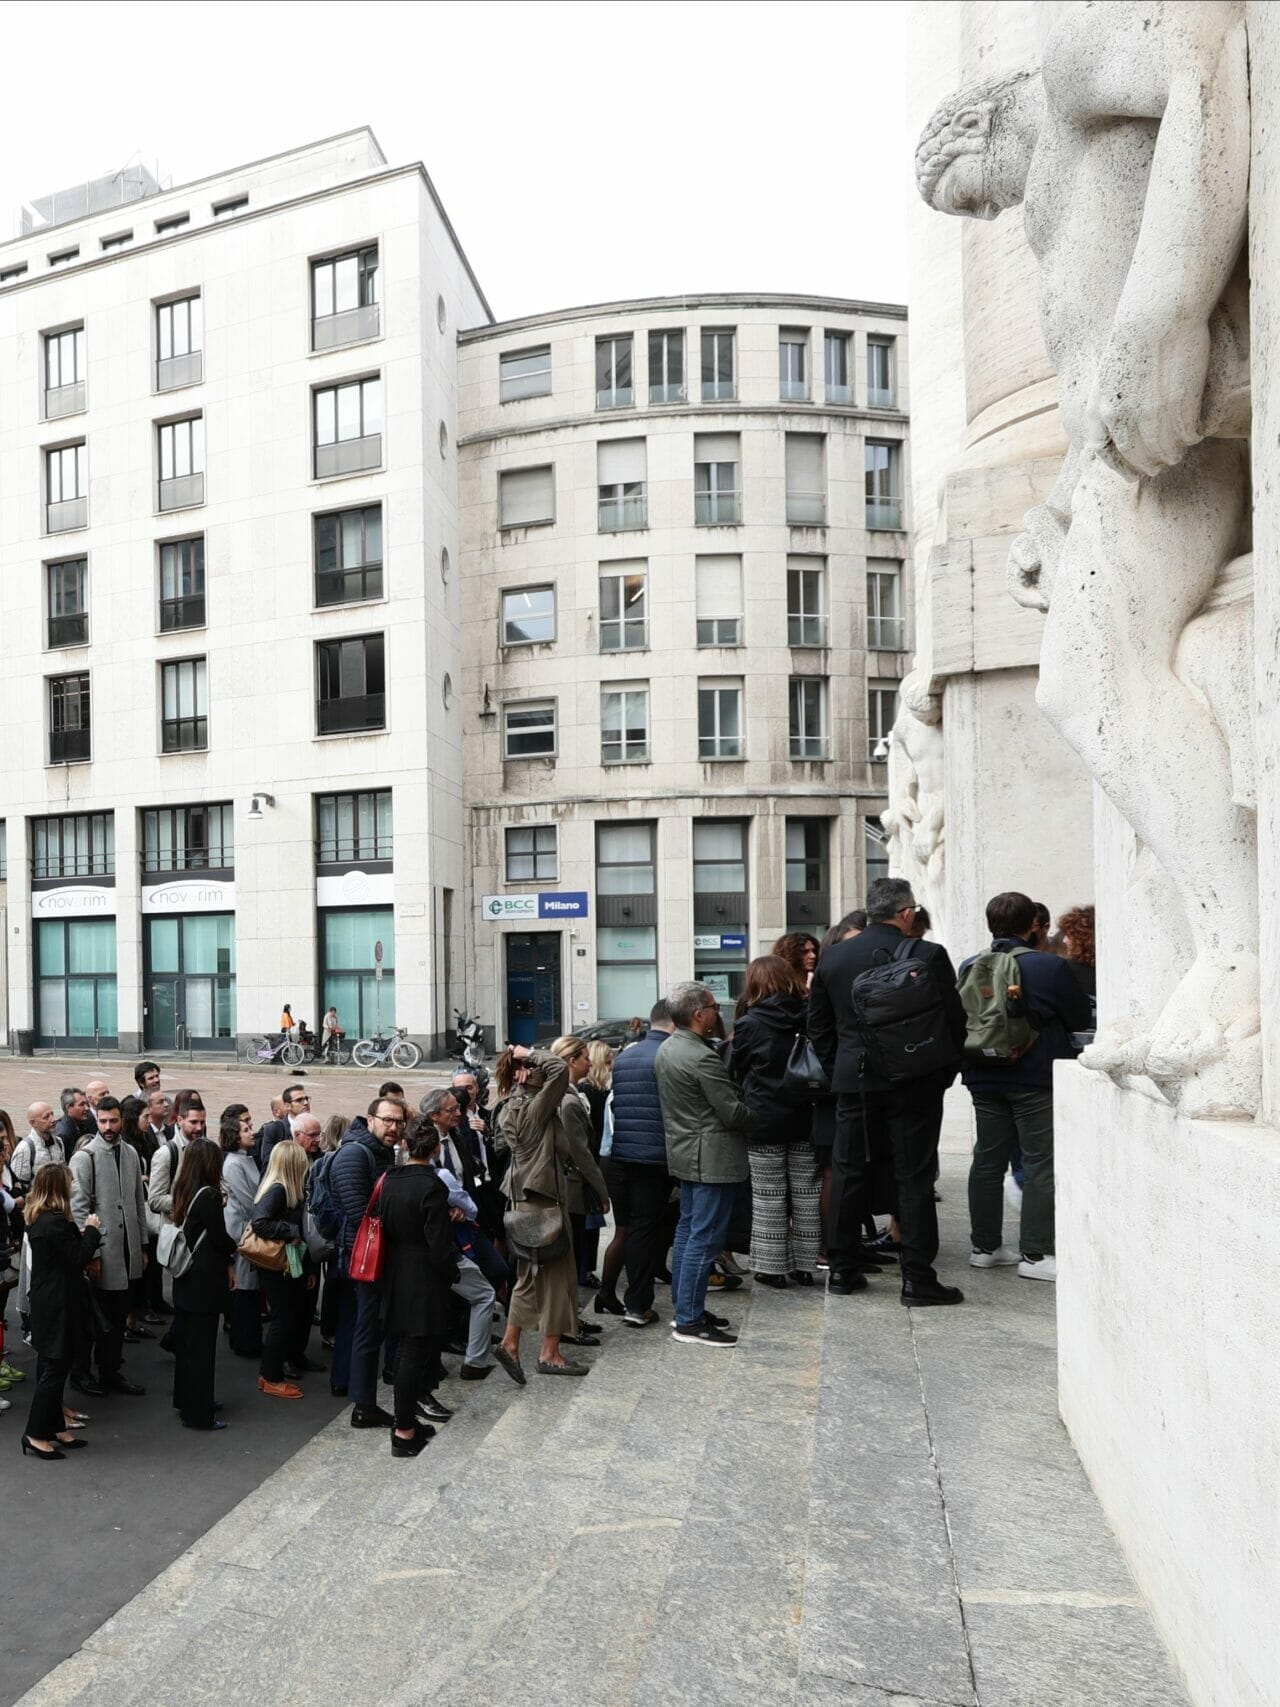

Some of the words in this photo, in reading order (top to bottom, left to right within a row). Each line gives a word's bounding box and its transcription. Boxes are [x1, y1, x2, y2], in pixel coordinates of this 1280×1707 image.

[47, 894, 107, 909] novrim
[159, 889, 223, 905] novrim
[504, 900, 535, 909] BCC
[544, 902, 580, 910] Milano
